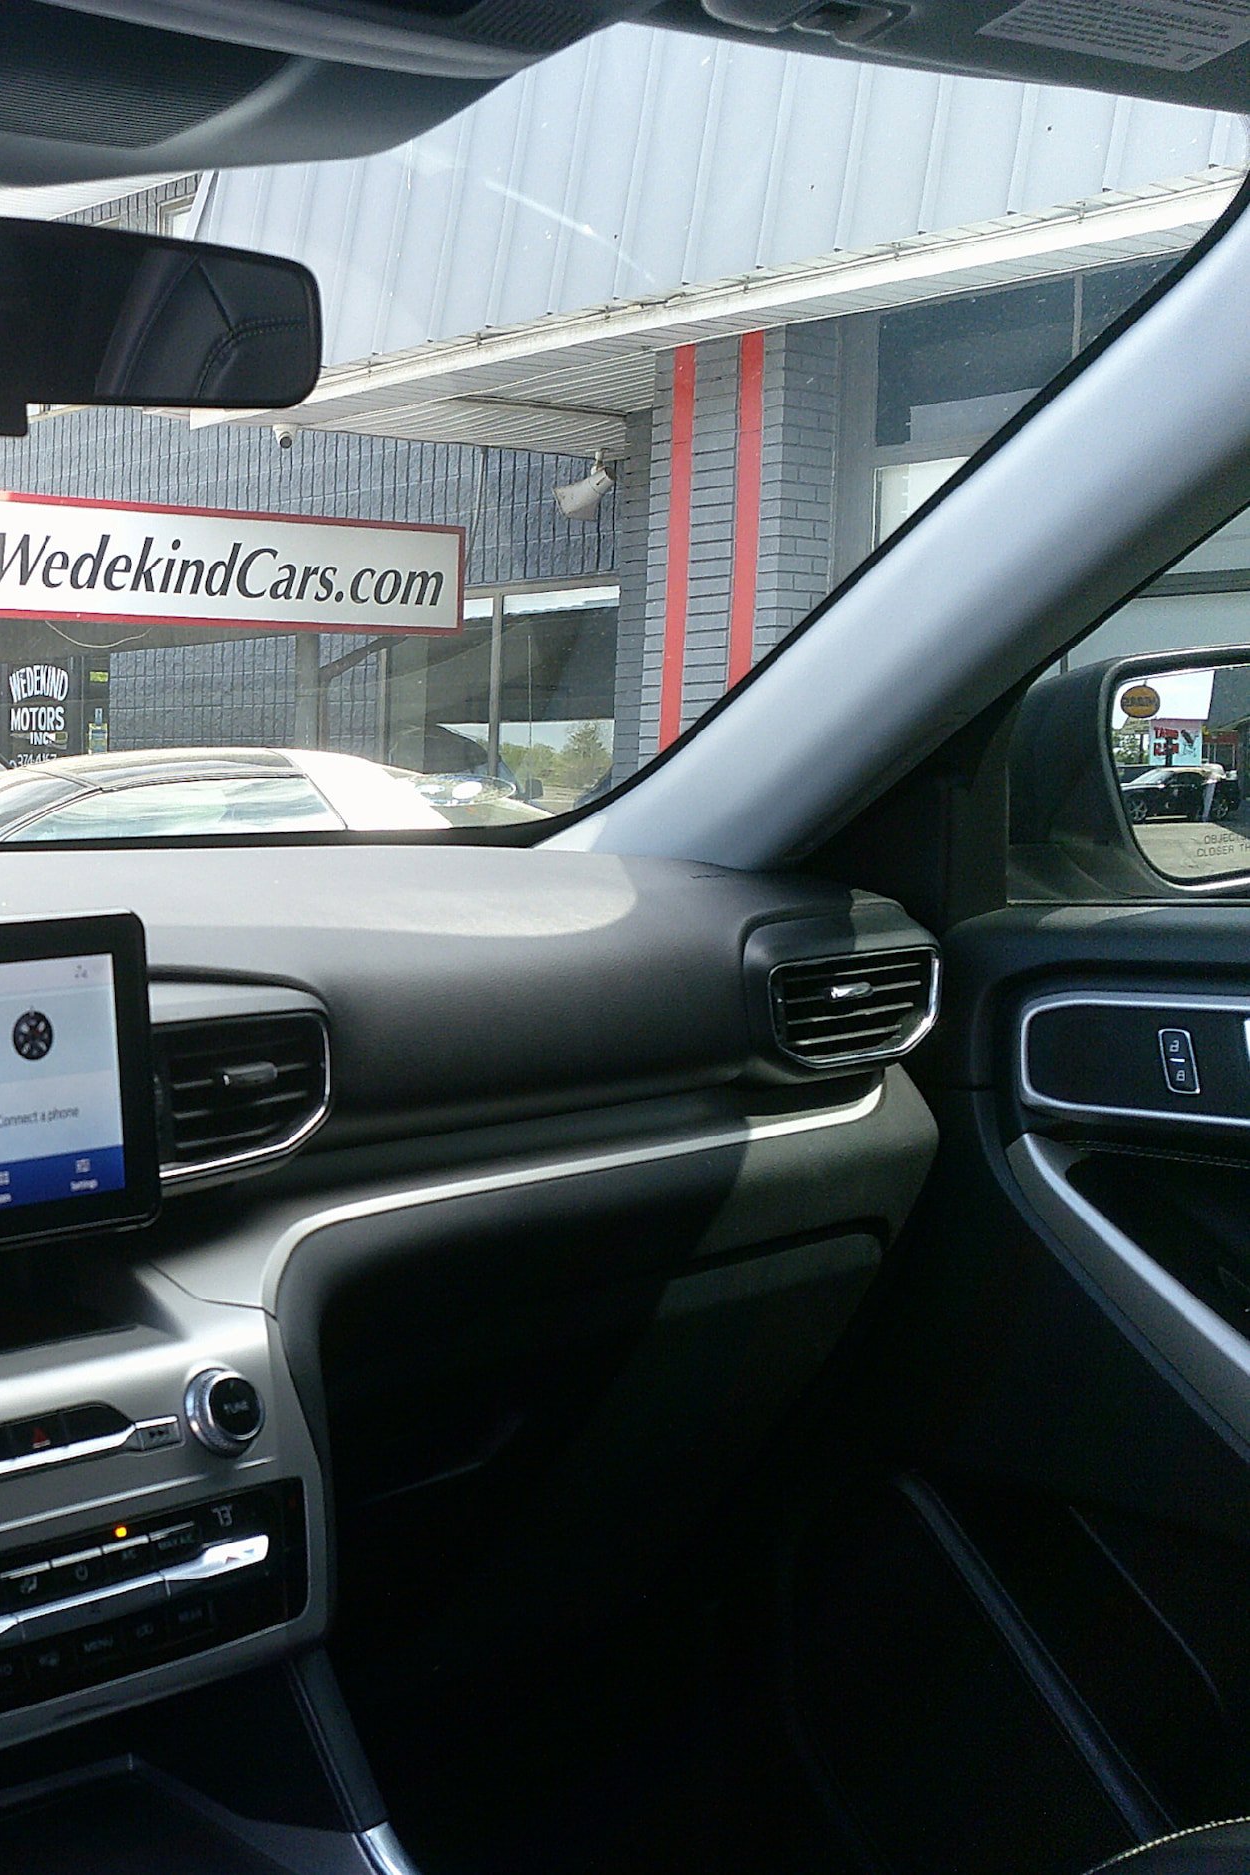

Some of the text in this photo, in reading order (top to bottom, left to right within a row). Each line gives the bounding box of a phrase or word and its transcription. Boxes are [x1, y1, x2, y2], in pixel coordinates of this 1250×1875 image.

[9, 664, 69, 703] WEDEKIND
[10, 705, 65, 731] MOTORS
[1196, 845, 1235, 858] CLOSER
[47, 1106, 80, 1124] phone
